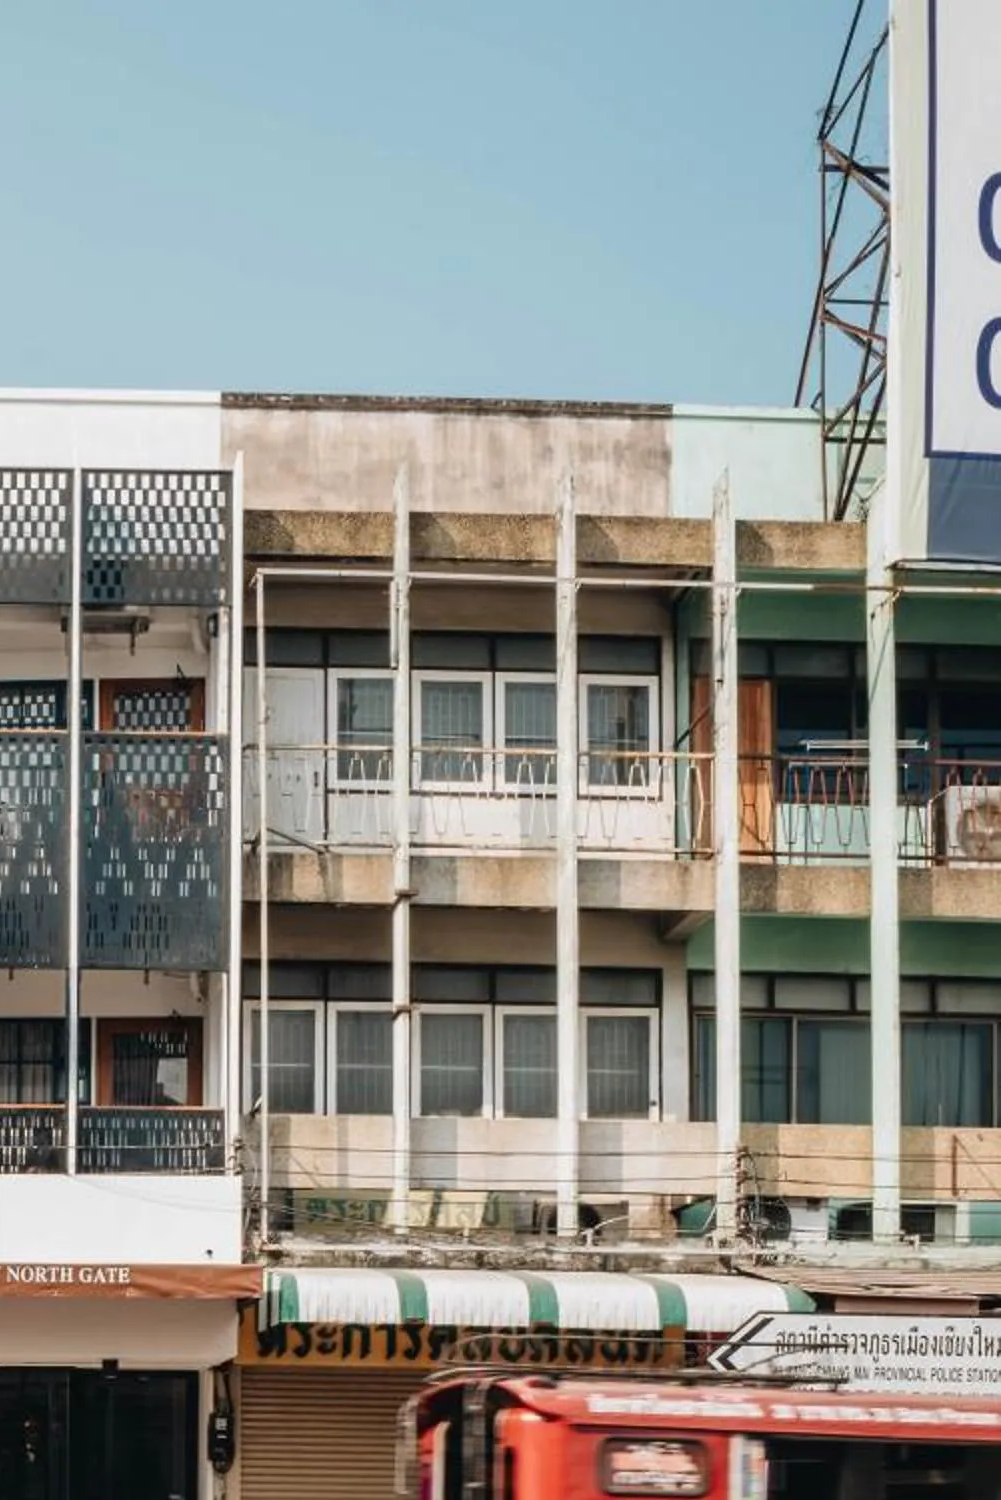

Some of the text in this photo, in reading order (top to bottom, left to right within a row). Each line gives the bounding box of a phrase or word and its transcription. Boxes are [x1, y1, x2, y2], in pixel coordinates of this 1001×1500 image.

[6, 1266, 74, 1283] NORTH
[78, 1266, 131, 1284] GATE
[874, 1367, 927, 1382] PROVINCIAL
[931, 1368, 963, 1383] POLICE
